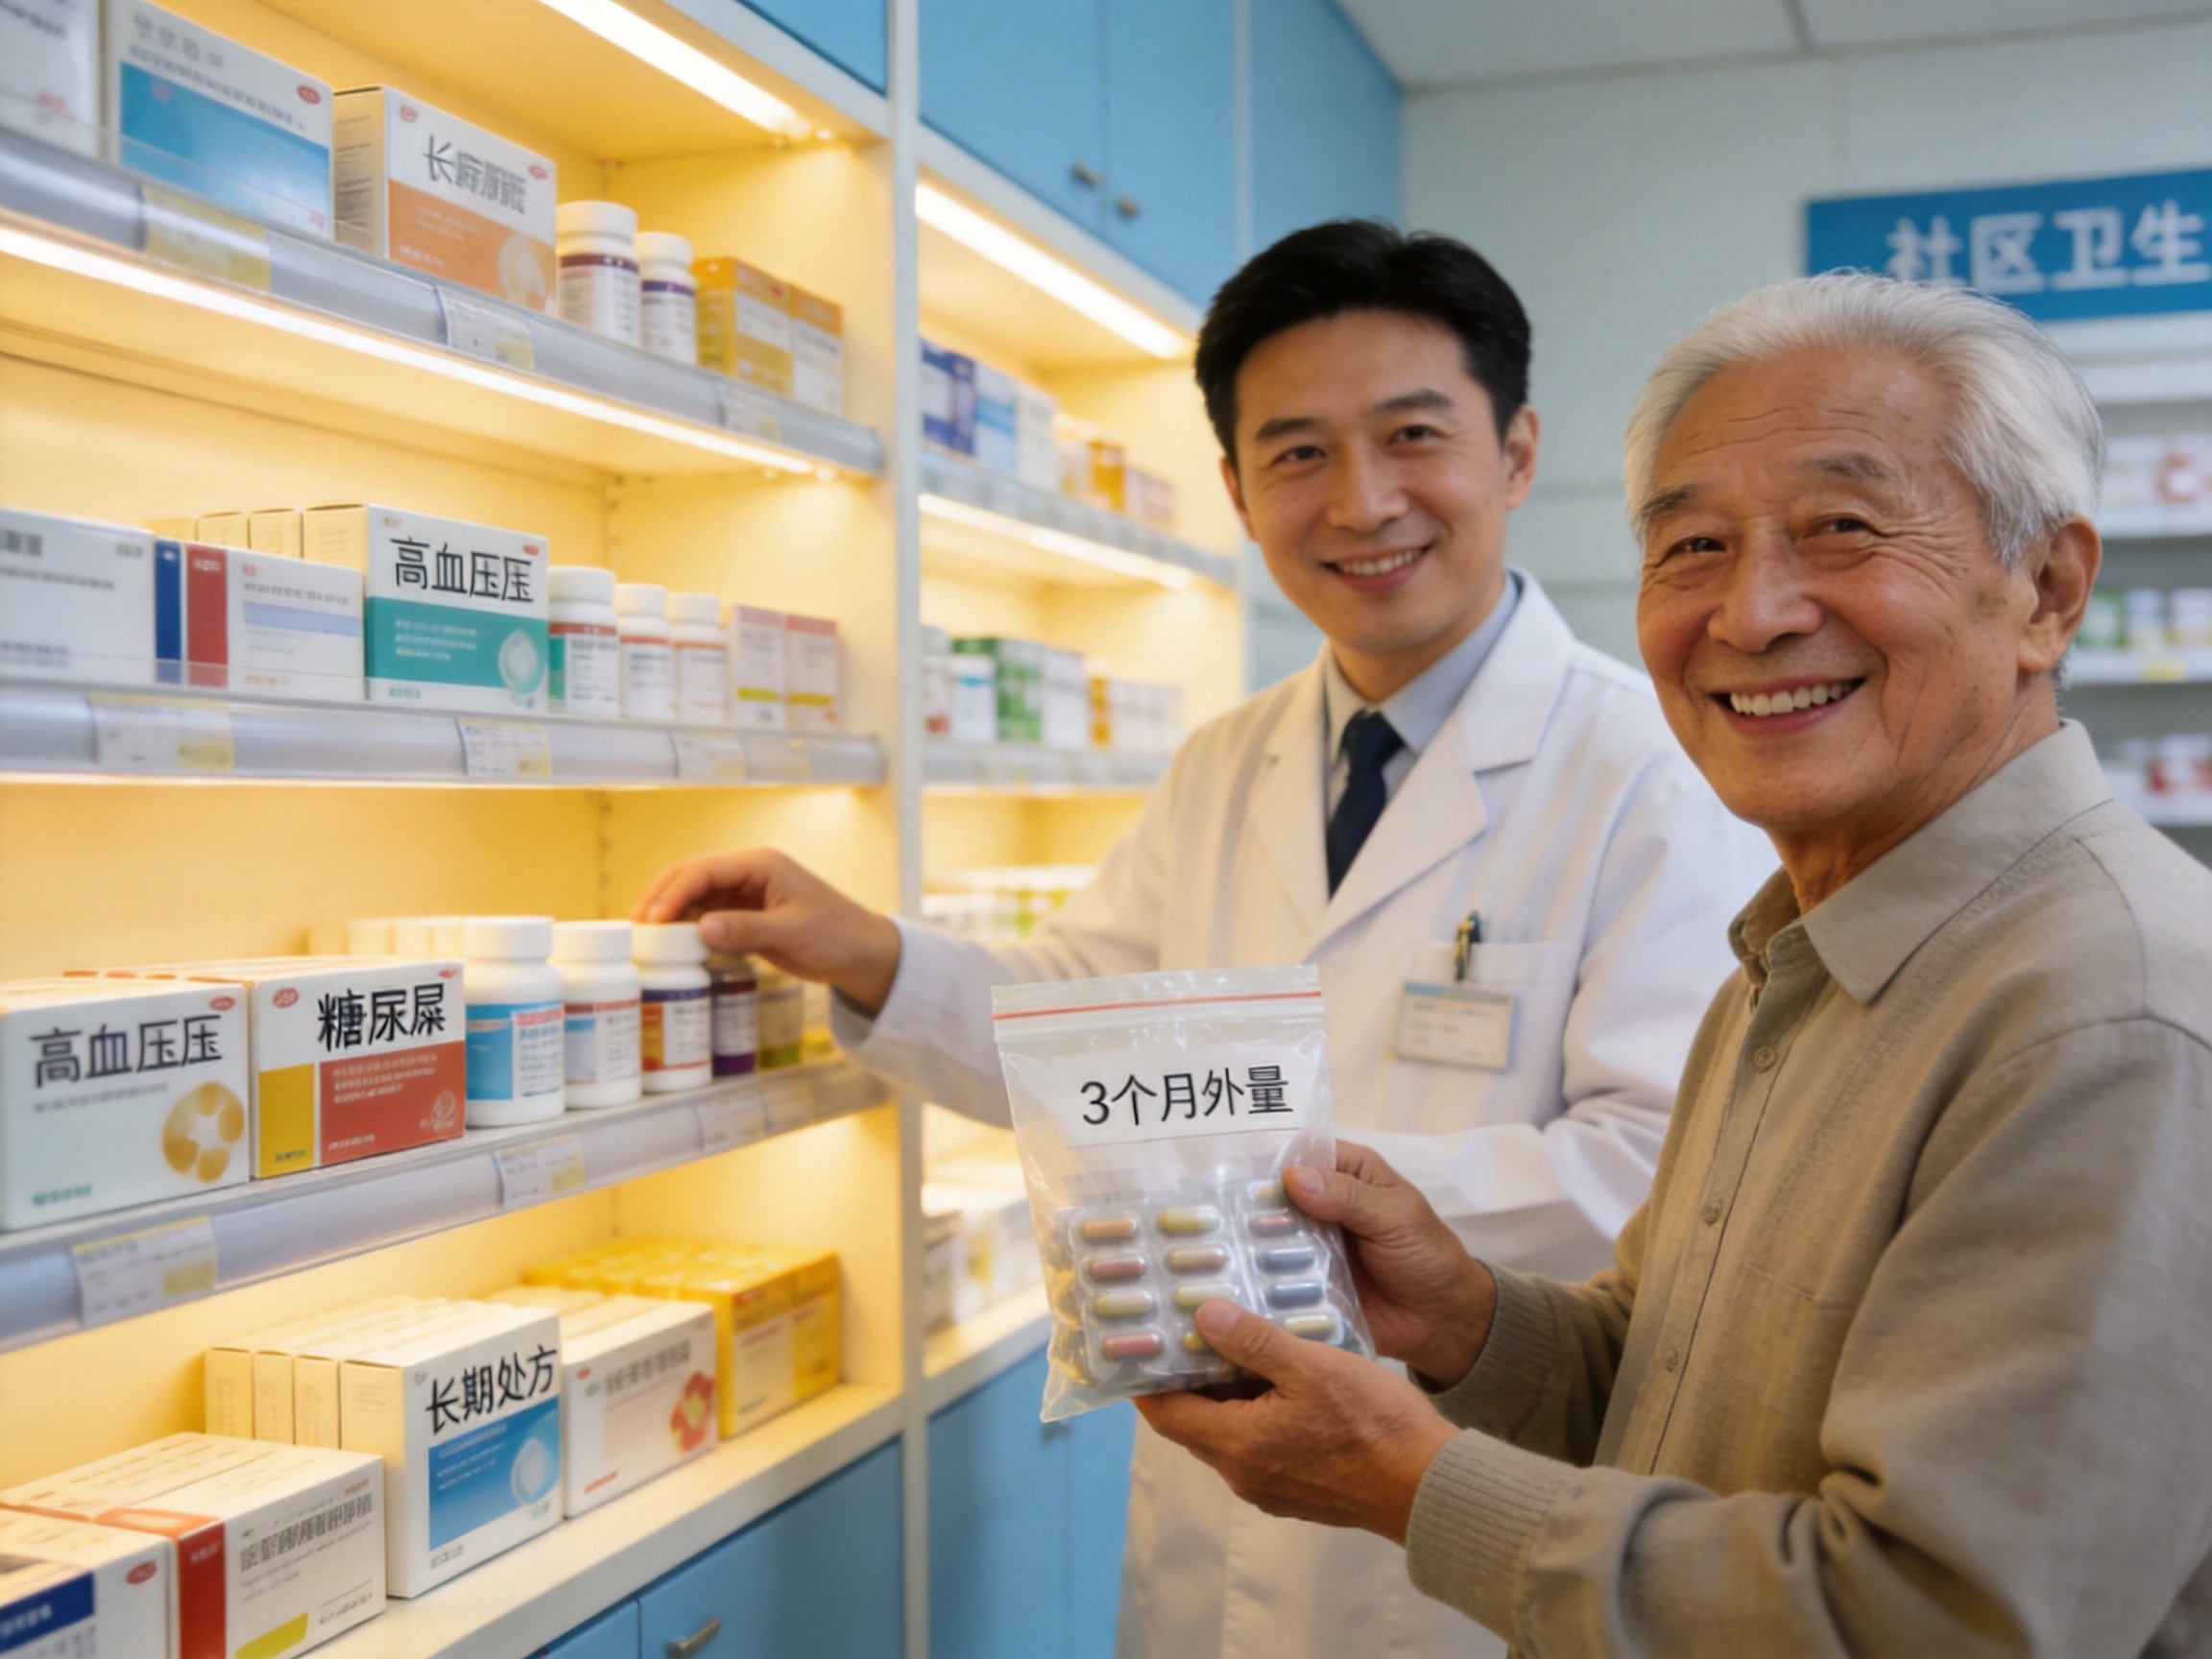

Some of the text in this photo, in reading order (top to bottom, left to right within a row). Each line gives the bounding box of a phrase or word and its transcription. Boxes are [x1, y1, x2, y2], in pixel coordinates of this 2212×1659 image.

[1080, 1065, 1294, 1126] 3个月外量
[425, 1344, 557, 1435] 长期处方
